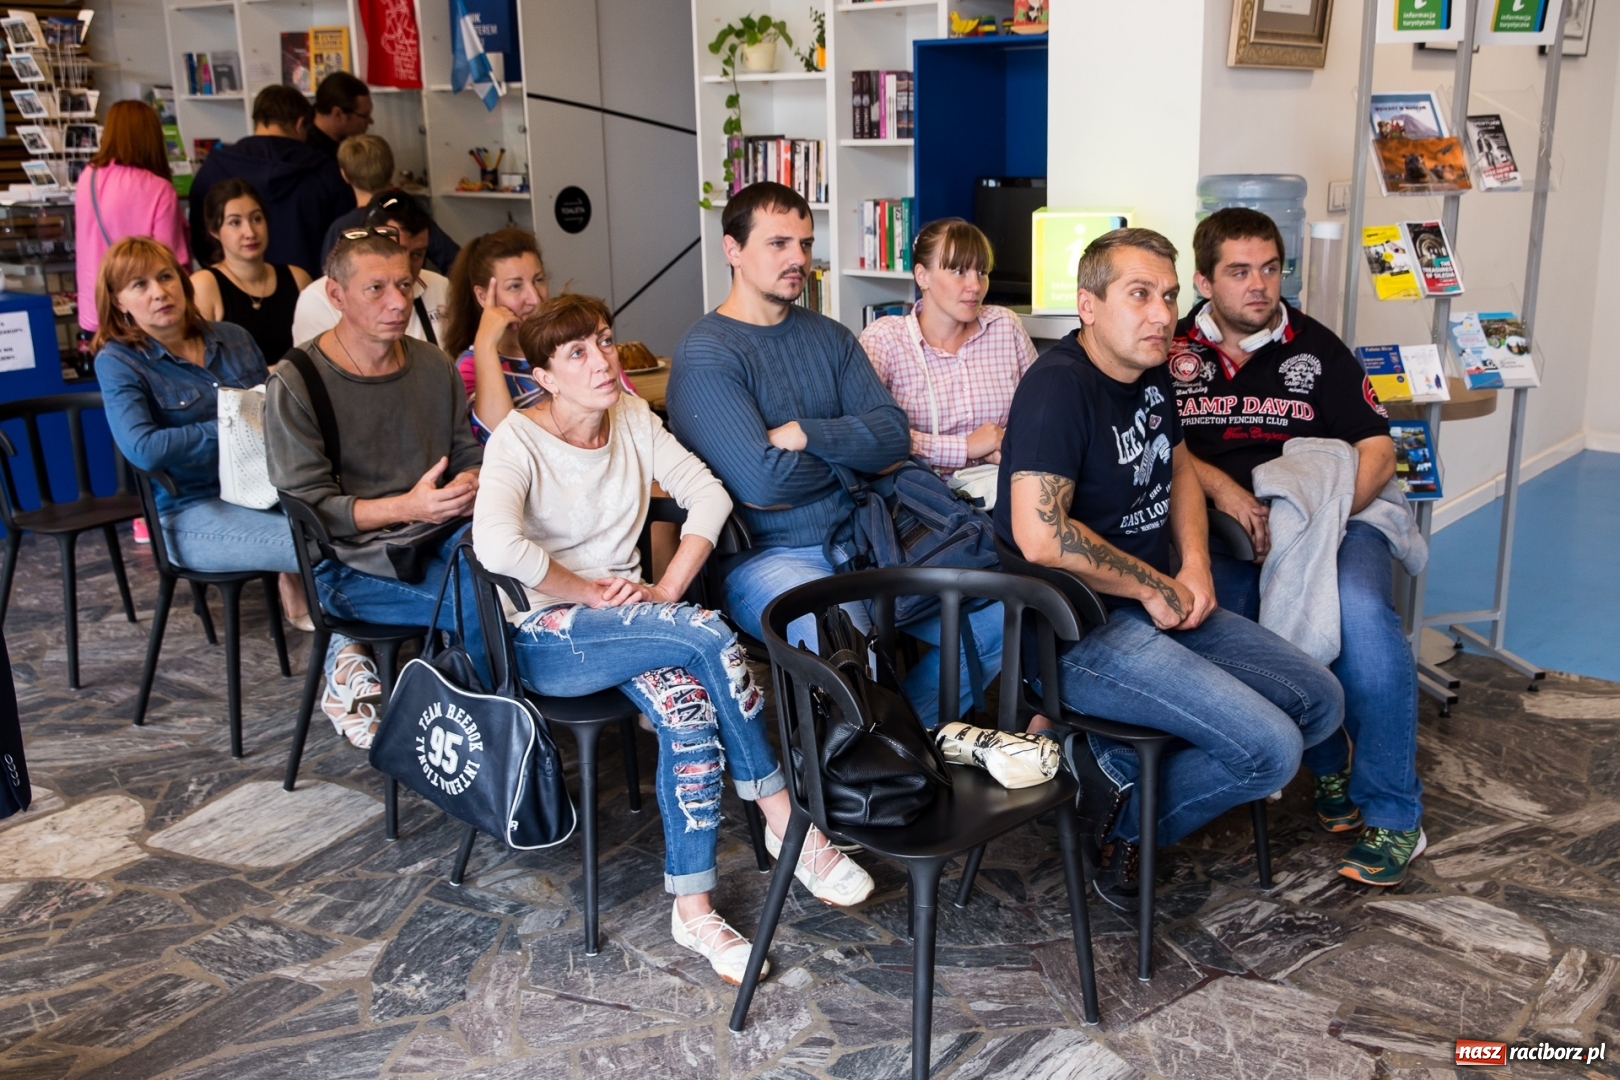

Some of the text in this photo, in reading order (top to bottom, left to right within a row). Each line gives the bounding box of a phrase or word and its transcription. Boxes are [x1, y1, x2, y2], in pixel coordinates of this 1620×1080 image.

[1403, 11, 1436, 19] informacja
[1500, 14, 1532, 22] informacja
[1242, 396, 1315, 421] DAVID
[1181, 416, 1289, 427] PRINCETON FENCING CLUB
[1111, 426, 1144, 465] LEE
[1120, 510, 1146, 528] EAST
[418, 702, 484, 752] TEAM REEBOK
[428, 725, 464, 775] 95
[416, 736, 480, 795] INTERNATIONAL
